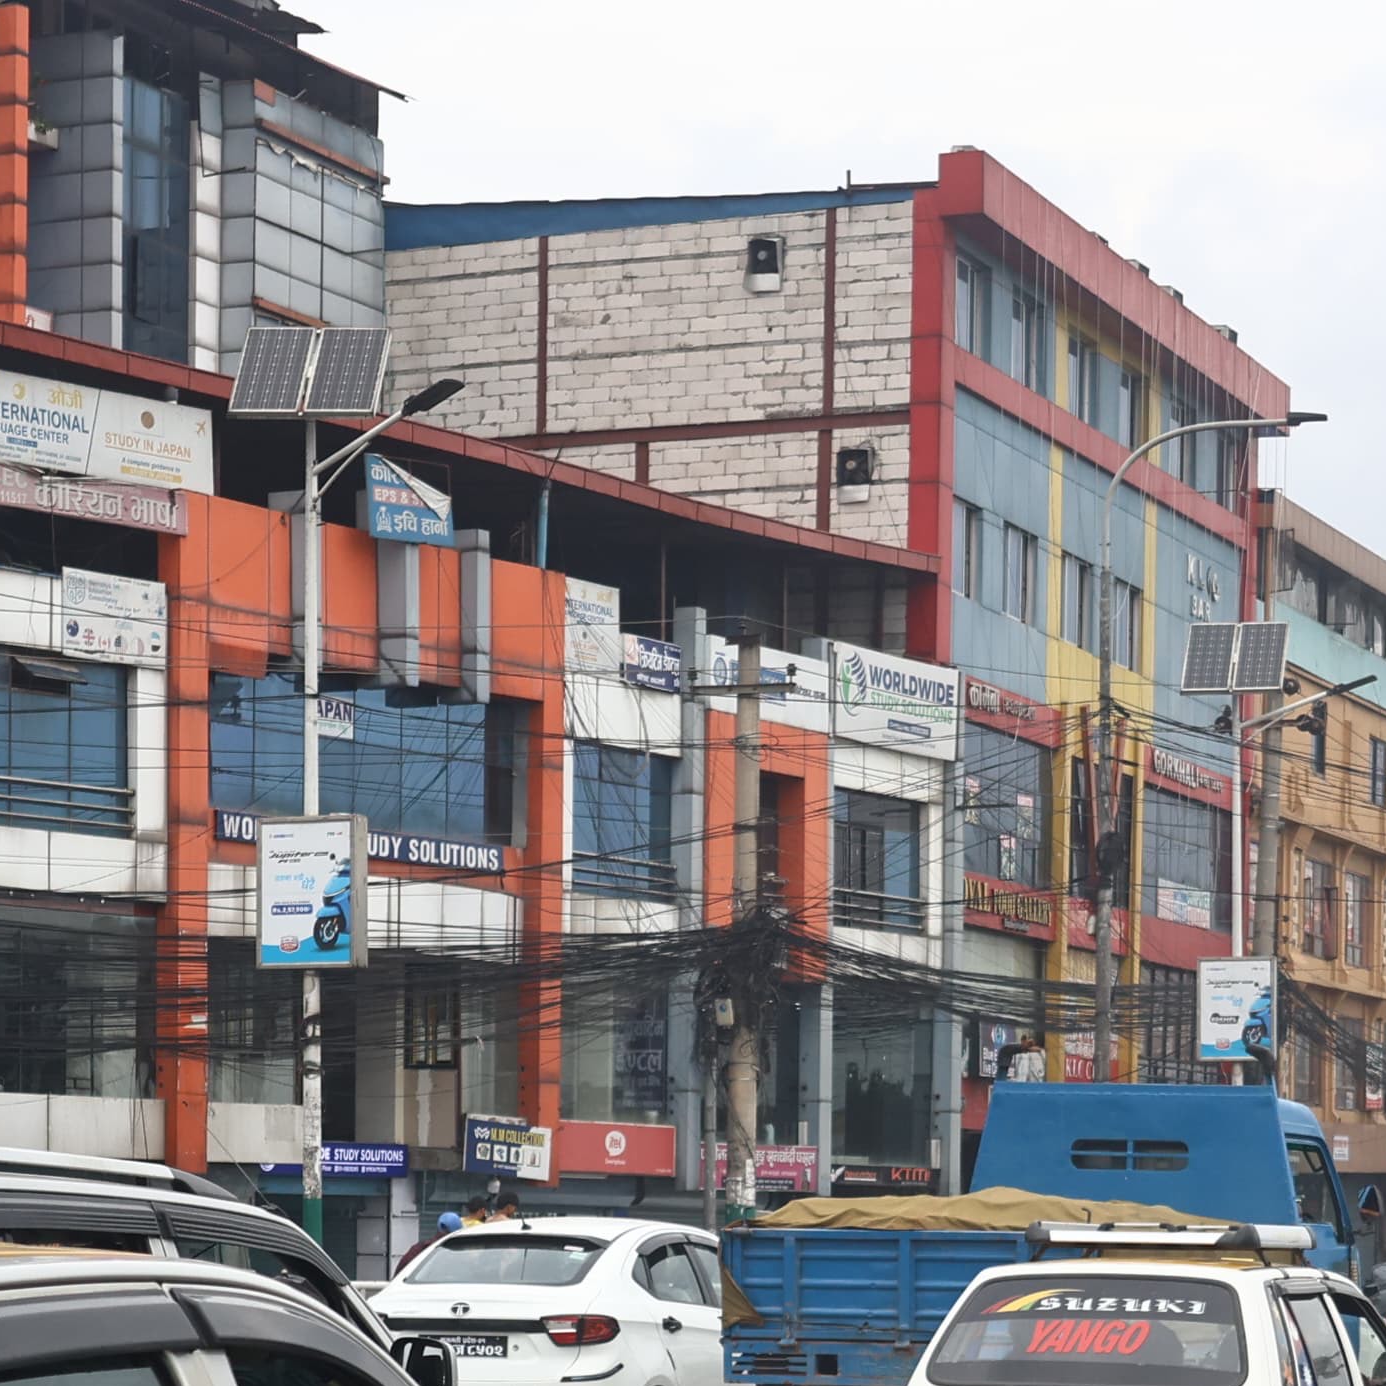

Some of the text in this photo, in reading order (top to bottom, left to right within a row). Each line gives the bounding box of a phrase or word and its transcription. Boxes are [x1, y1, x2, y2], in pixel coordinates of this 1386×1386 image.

[30, 426, 69, 445] CENTER
[104, 432, 191, 459] STUDY IN JAPAN
[375, 488, 396, 503] EPS
[400, 494, 409, 504] &
[869, 664, 954, 705] WORLDWIDE
[317, 700, 352, 721] APAN
[870, 692, 953, 724] STUDY SOLUTIONS
[368, 833, 498, 871] UDY SOLUTIONS
[506, 1130, 545, 1147] COLLECTION
[334, 1148, 403, 1162] STUDY SOLUTIONS
[891, 1168, 930, 1182] KTM
[1035, 1297, 1207, 1315] SUZUKI
[1026, 1319, 1152, 1354] YANGO
